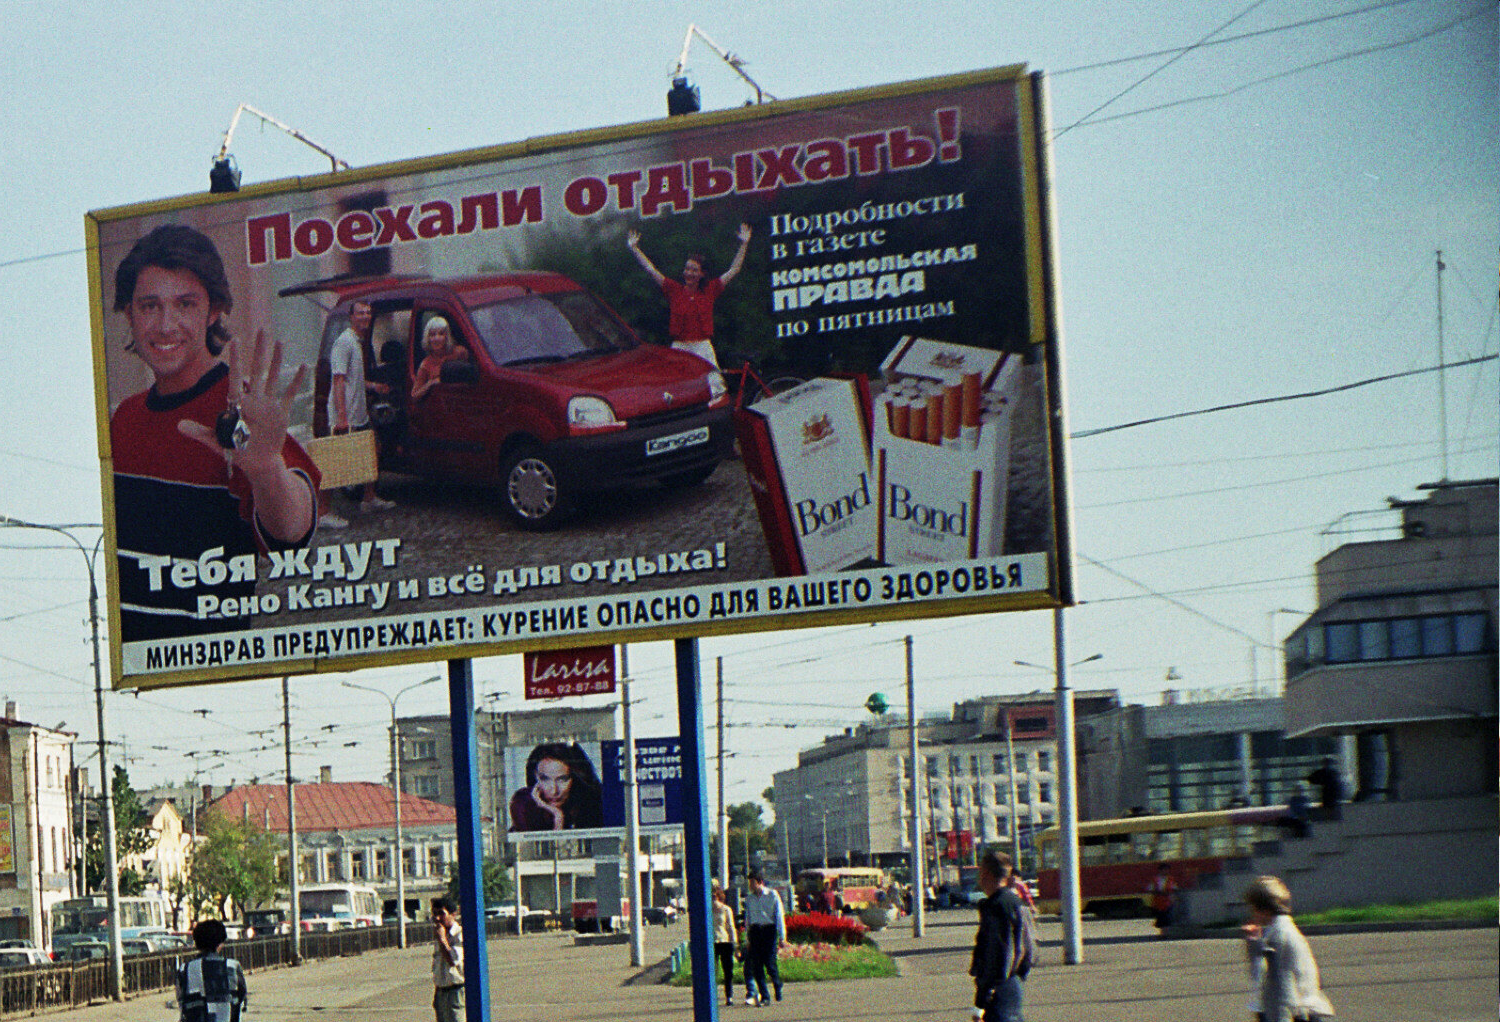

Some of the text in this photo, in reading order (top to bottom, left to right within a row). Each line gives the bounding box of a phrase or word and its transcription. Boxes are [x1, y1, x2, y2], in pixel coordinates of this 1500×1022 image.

[247, 106, 961, 266] Поехали отдыхать!
[770, 193, 964, 236] Подробности
[772, 228, 886, 259] в газете
[773, 270, 925, 311] ПРАВДА
[776, 301, 955, 338] по пятницам
[796, 472, 871, 536] Bond
[890, 483, 967, 537] Bond
[138, 538, 401, 591] Тебя ждут
[197, 542, 727, 619] Рено Кангу и всё для отдыха!
[146, 562, 1023, 670] МИНЗДРАВ ПРЕДУПРЕЖДАЕТ: КУРЕНИЕ ОПАСНО ДЛЯ ВАШЕГО ЗДОРОВЬЯ
[532, 658, 609, 682] Larisa
